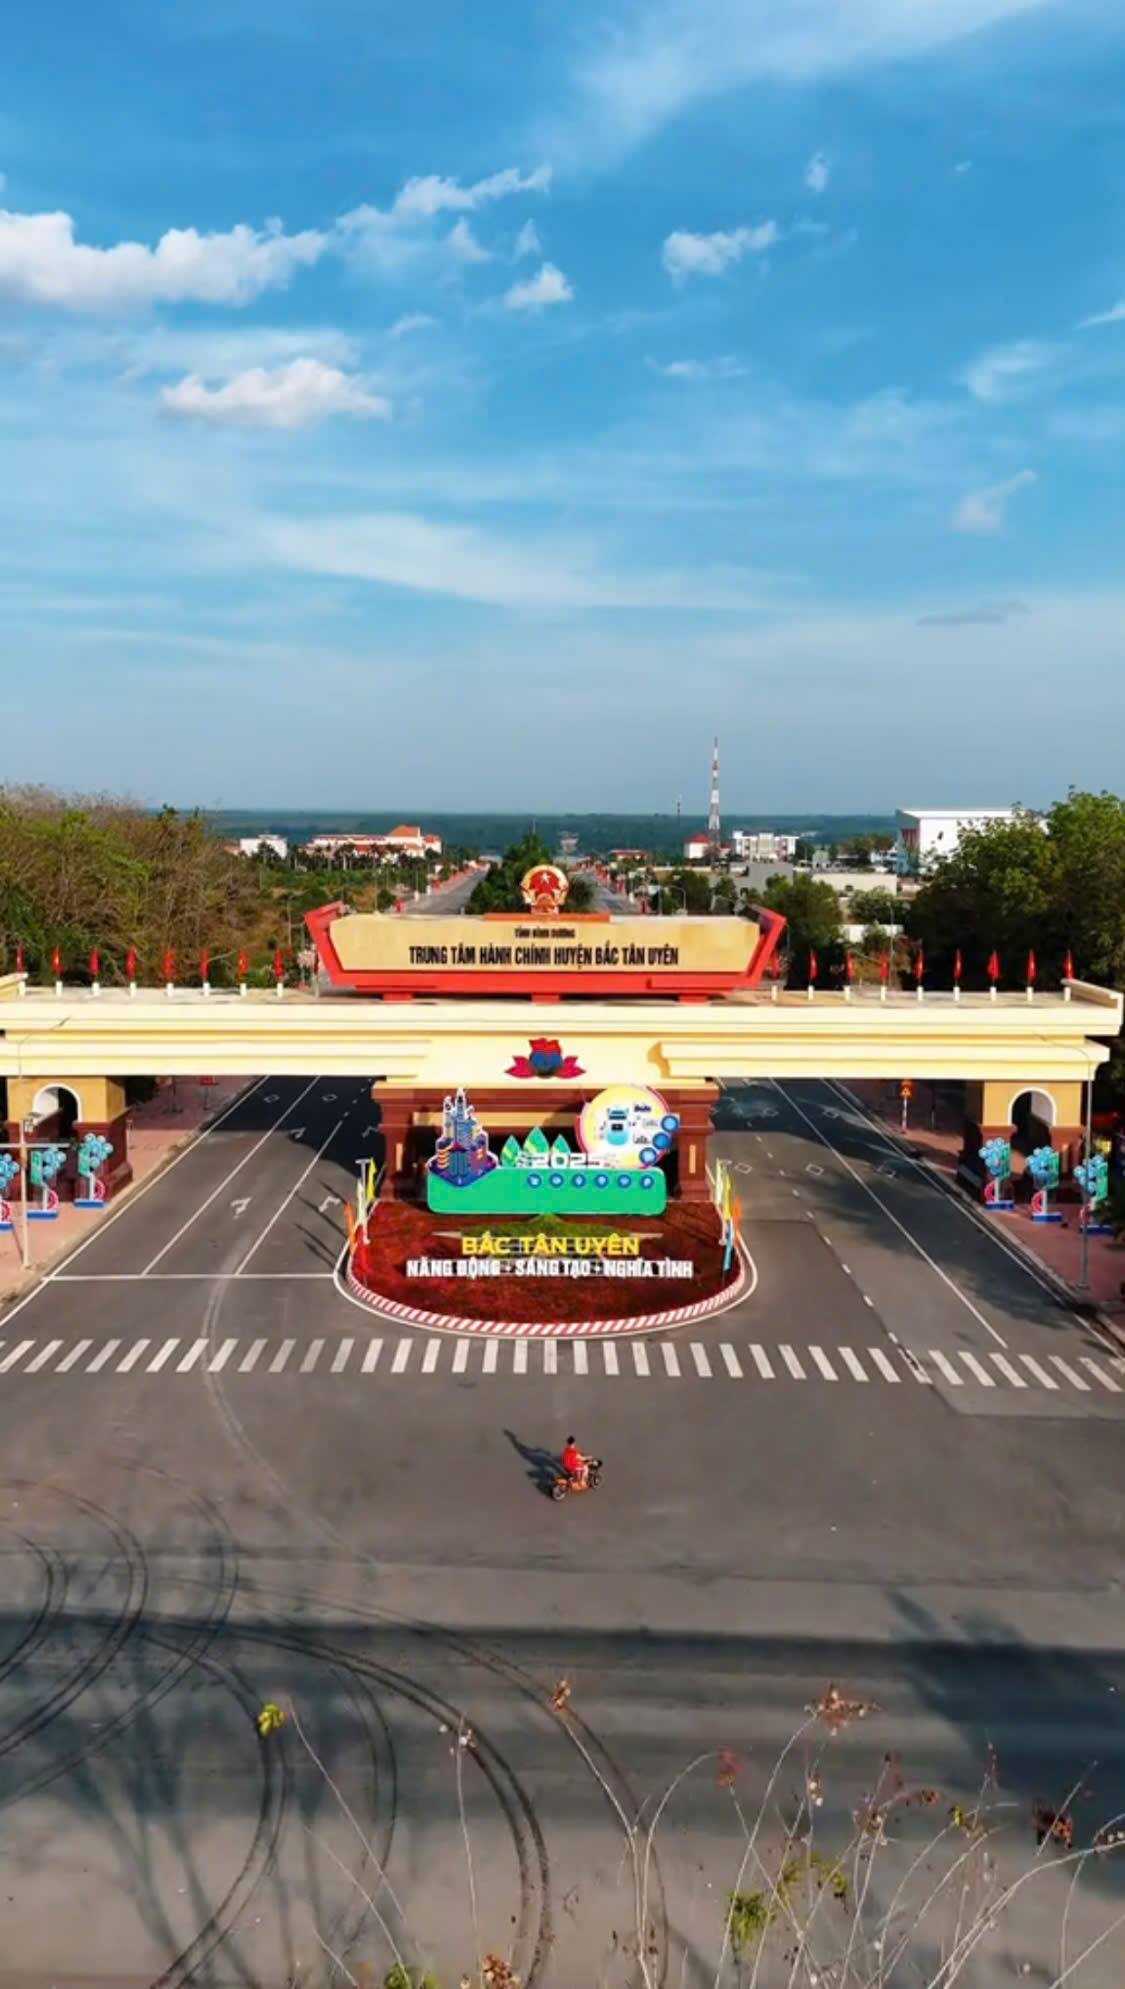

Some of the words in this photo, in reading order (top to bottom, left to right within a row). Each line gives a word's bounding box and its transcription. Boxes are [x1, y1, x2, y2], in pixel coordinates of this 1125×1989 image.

[409, 946, 448, 964] TRUNG
[450, 942, 476, 964] TÂM
[480, 942, 512, 964] HÀNH
[515, 943, 551, 964] CHÍNH
[554, 943, 592, 969] HUYỆN
[595, 940, 619, 965] BẮC
[621, 943, 645, 965] TÂN
[648, 943, 679, 965] UYÊN
[462, 1230, 511, 1255] BẮC
[519, 1233, 567, 1254] TÂN
[574, 1233, 640, 1255] UYÊN
[406, 1256, 453, 1277] NĂNG
[456, 1256, 500, 1279] ĐỘNG
[515, 1255, 559, 1277] SÁNG
[563, 1259, 590, 1279] TẠO
[603, 1257, 653, 1277] NGHĨA
[658, 1256, 693, 1278] TÌNH
